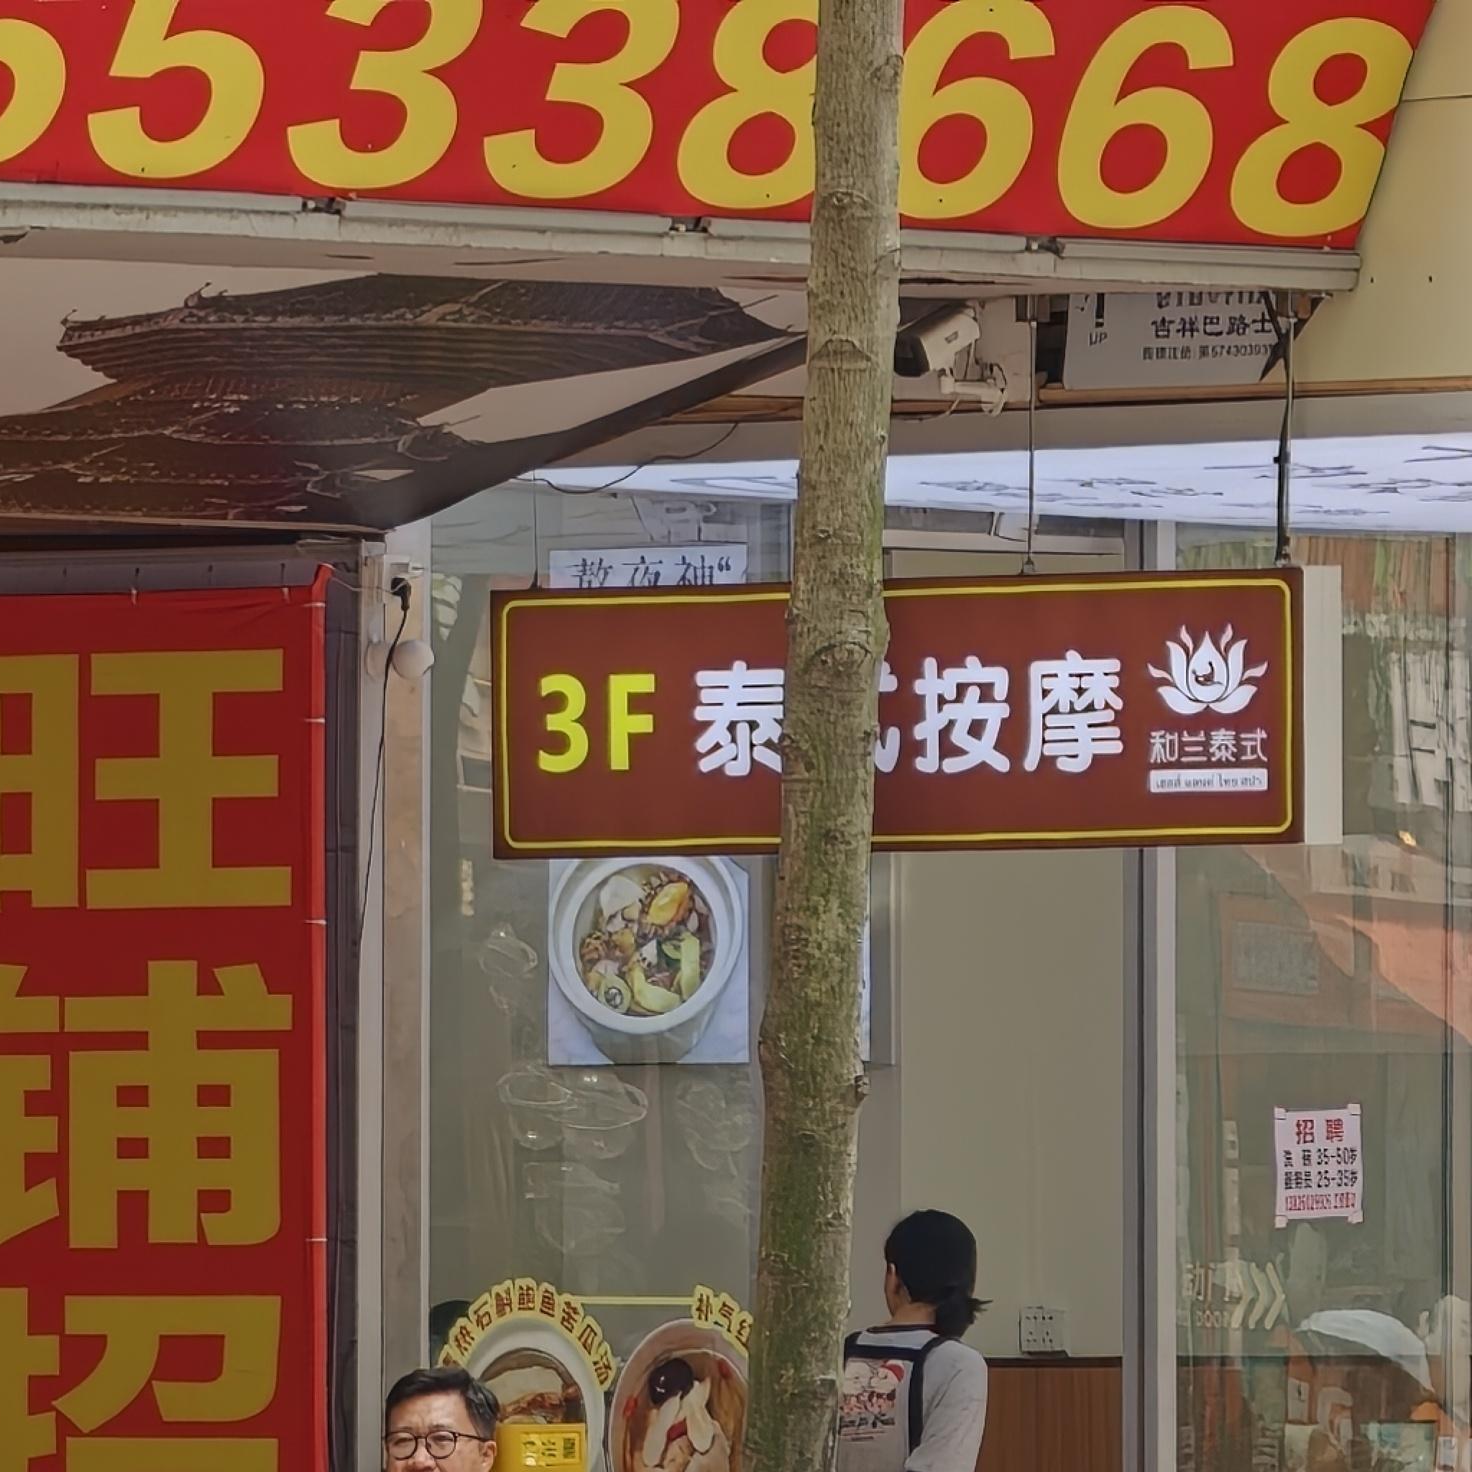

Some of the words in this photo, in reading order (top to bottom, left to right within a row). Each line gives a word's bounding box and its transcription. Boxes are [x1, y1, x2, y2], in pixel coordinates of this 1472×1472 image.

[537, 672, 656, 774] 3F
[694, 649, 1125, 777] 泰按摩
[1149, 727, 1268, 764] 和兰泰式
